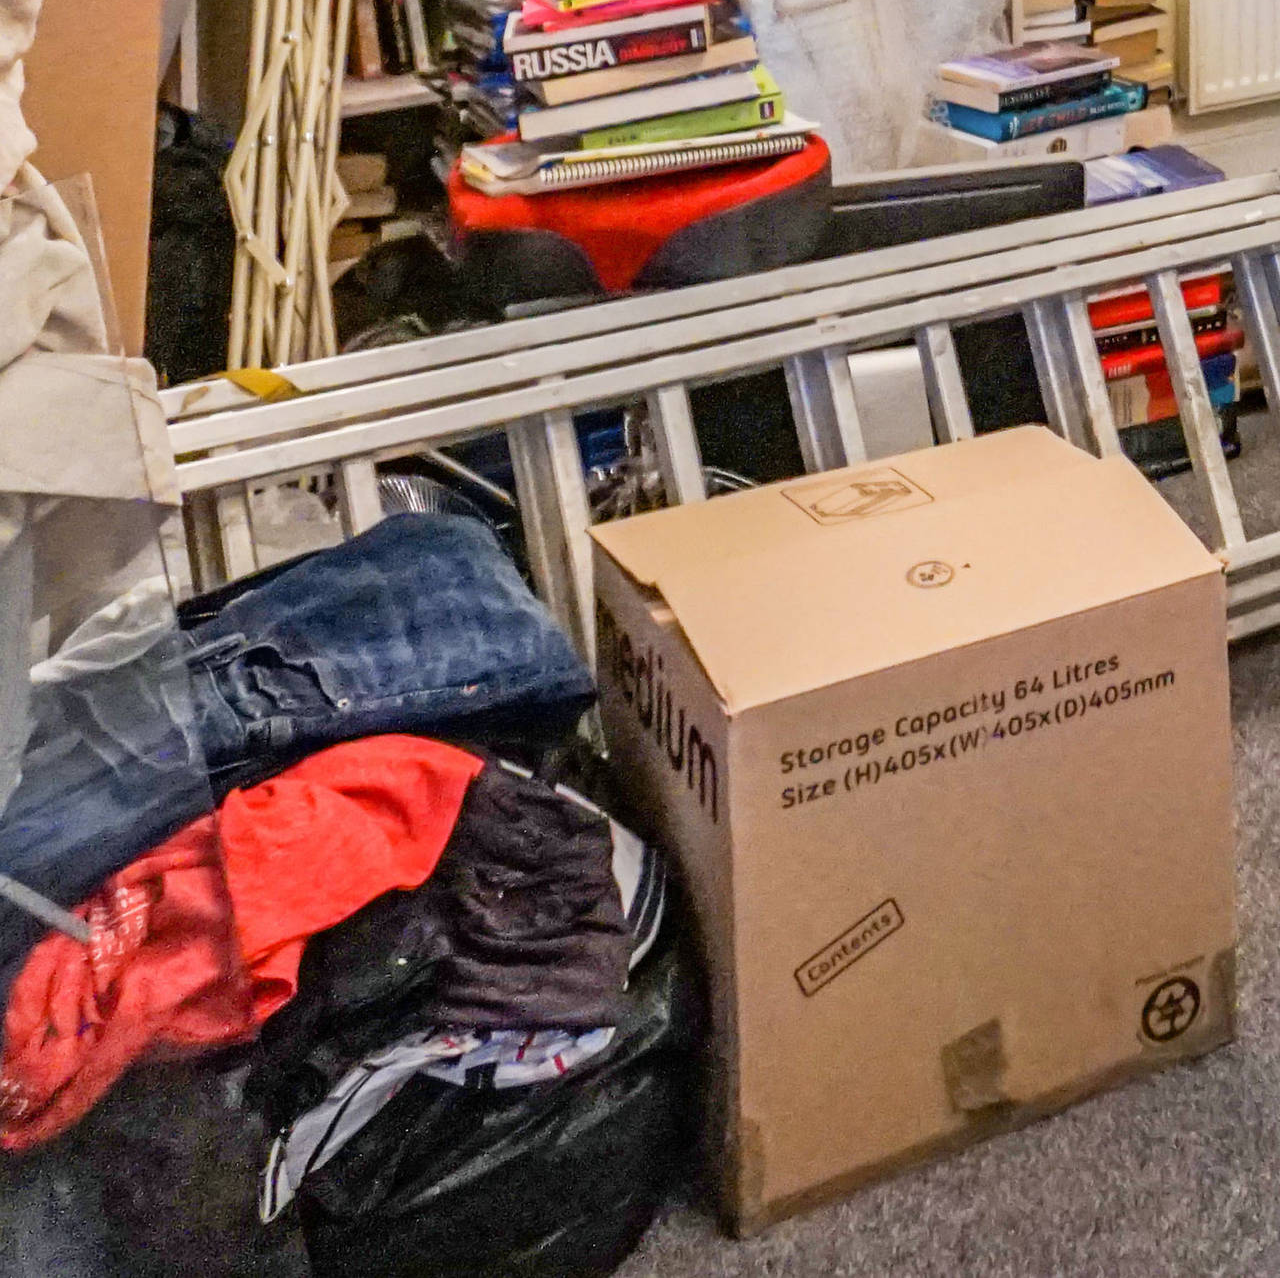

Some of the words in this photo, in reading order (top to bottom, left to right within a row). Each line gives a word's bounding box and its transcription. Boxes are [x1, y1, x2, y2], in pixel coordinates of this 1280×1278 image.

[512, 39, 619, 81] RUSSIA
[780, 725, 886, 774] Storage
[893, 692, 1007, 739] Capacity
[1013, 678, 1045, 701] 64
[1052, 654, 1120, 689] Litres
[781, 777, 837, 810] Size
[805, 911, 893, 985] Contents
